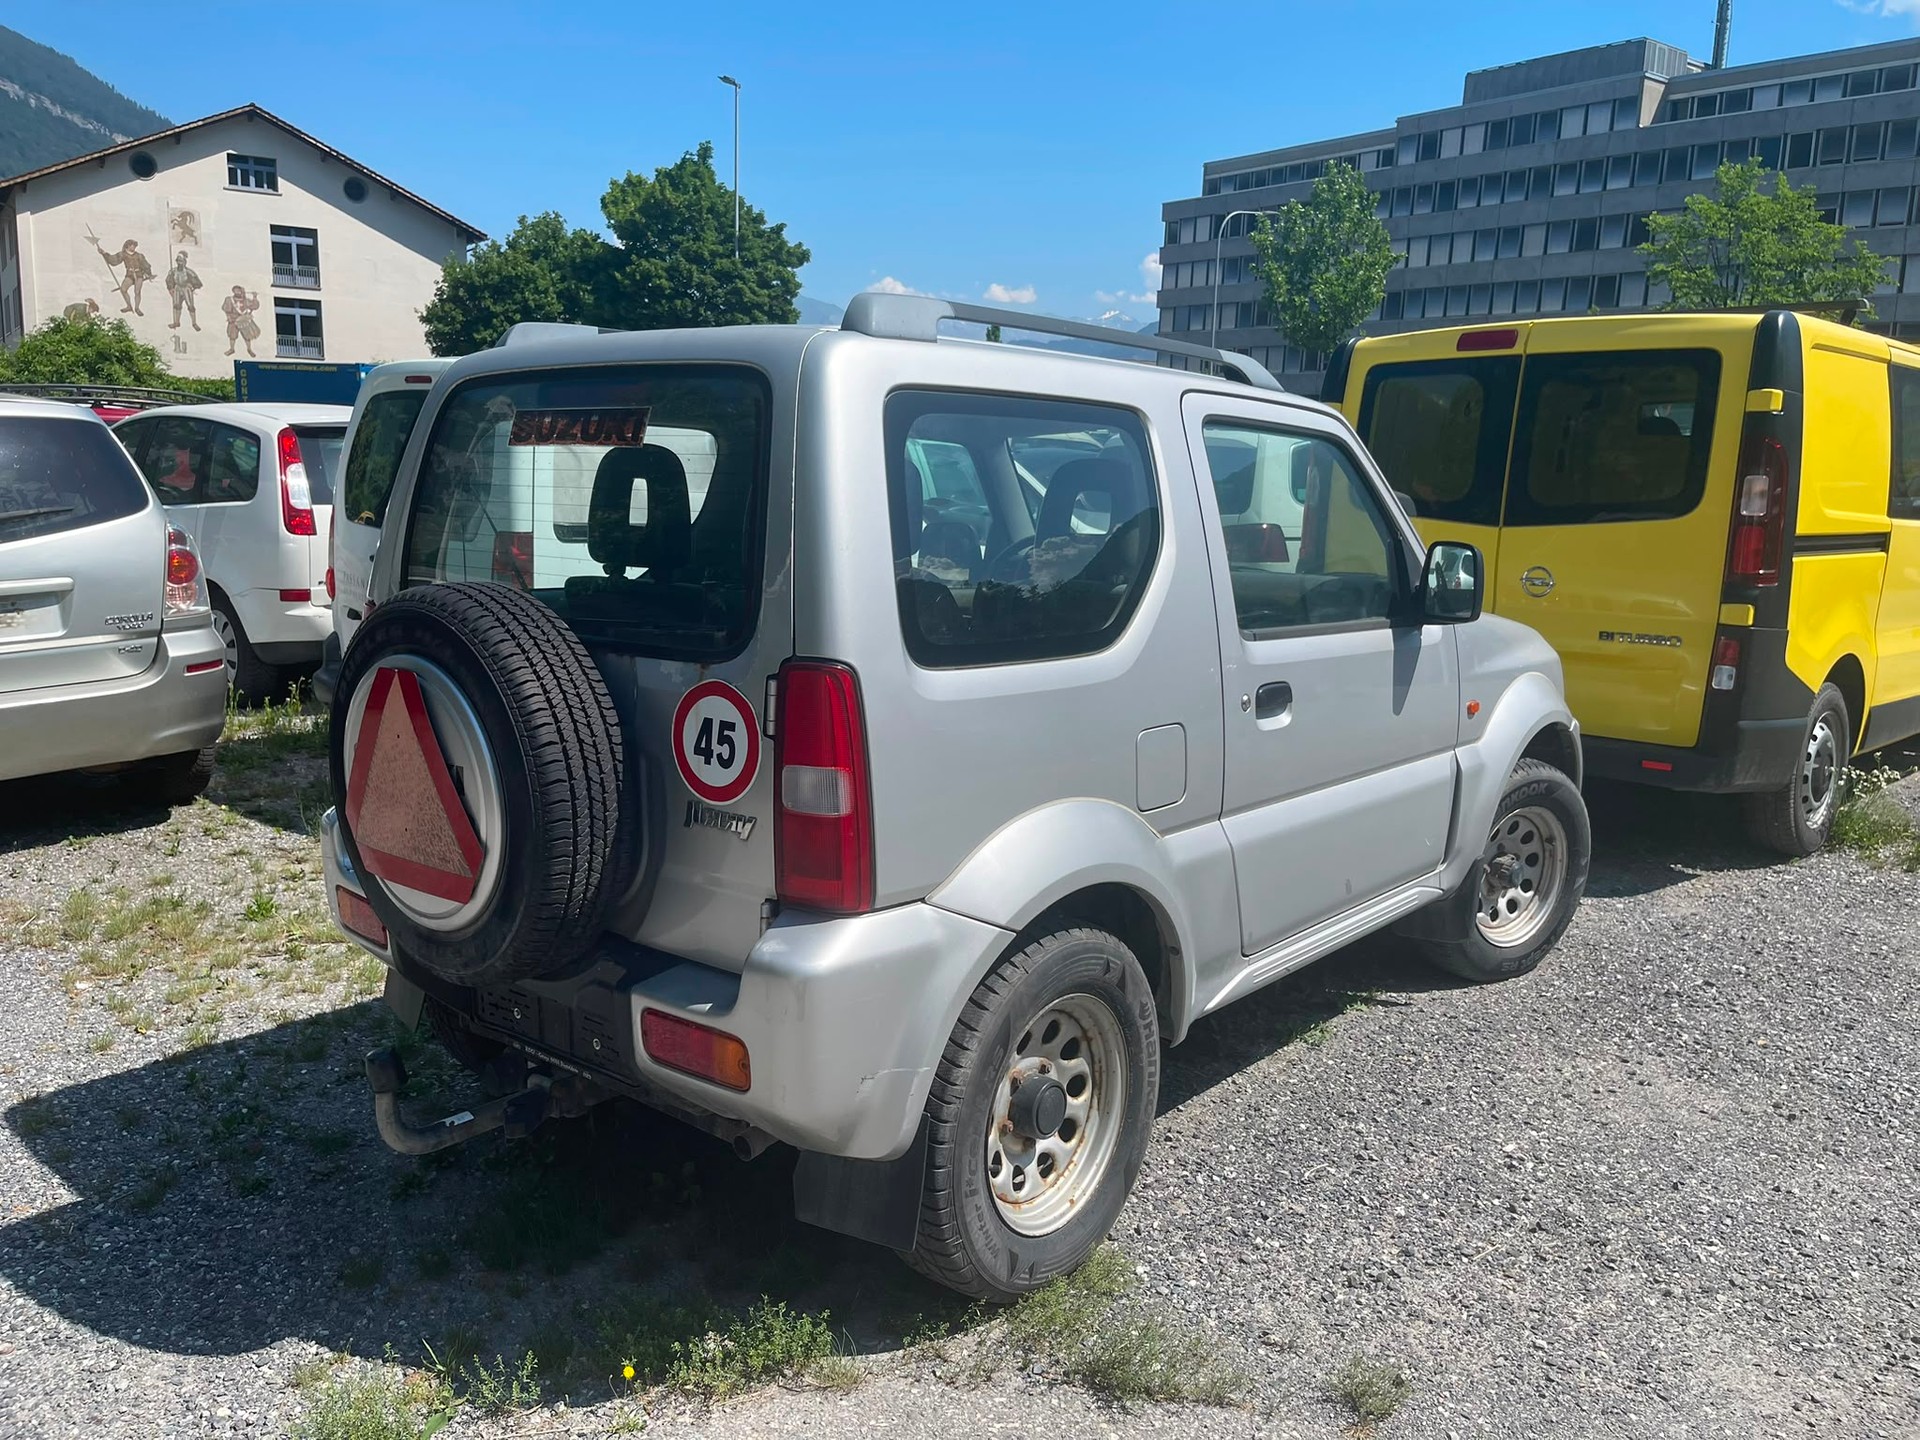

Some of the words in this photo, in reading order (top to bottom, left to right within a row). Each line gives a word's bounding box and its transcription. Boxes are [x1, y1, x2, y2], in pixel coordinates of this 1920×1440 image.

[510, 410, 646, 443] SUZUKI
[105, 611, 153, 625] COROLLA
[694, 716, 736, 770] 45
